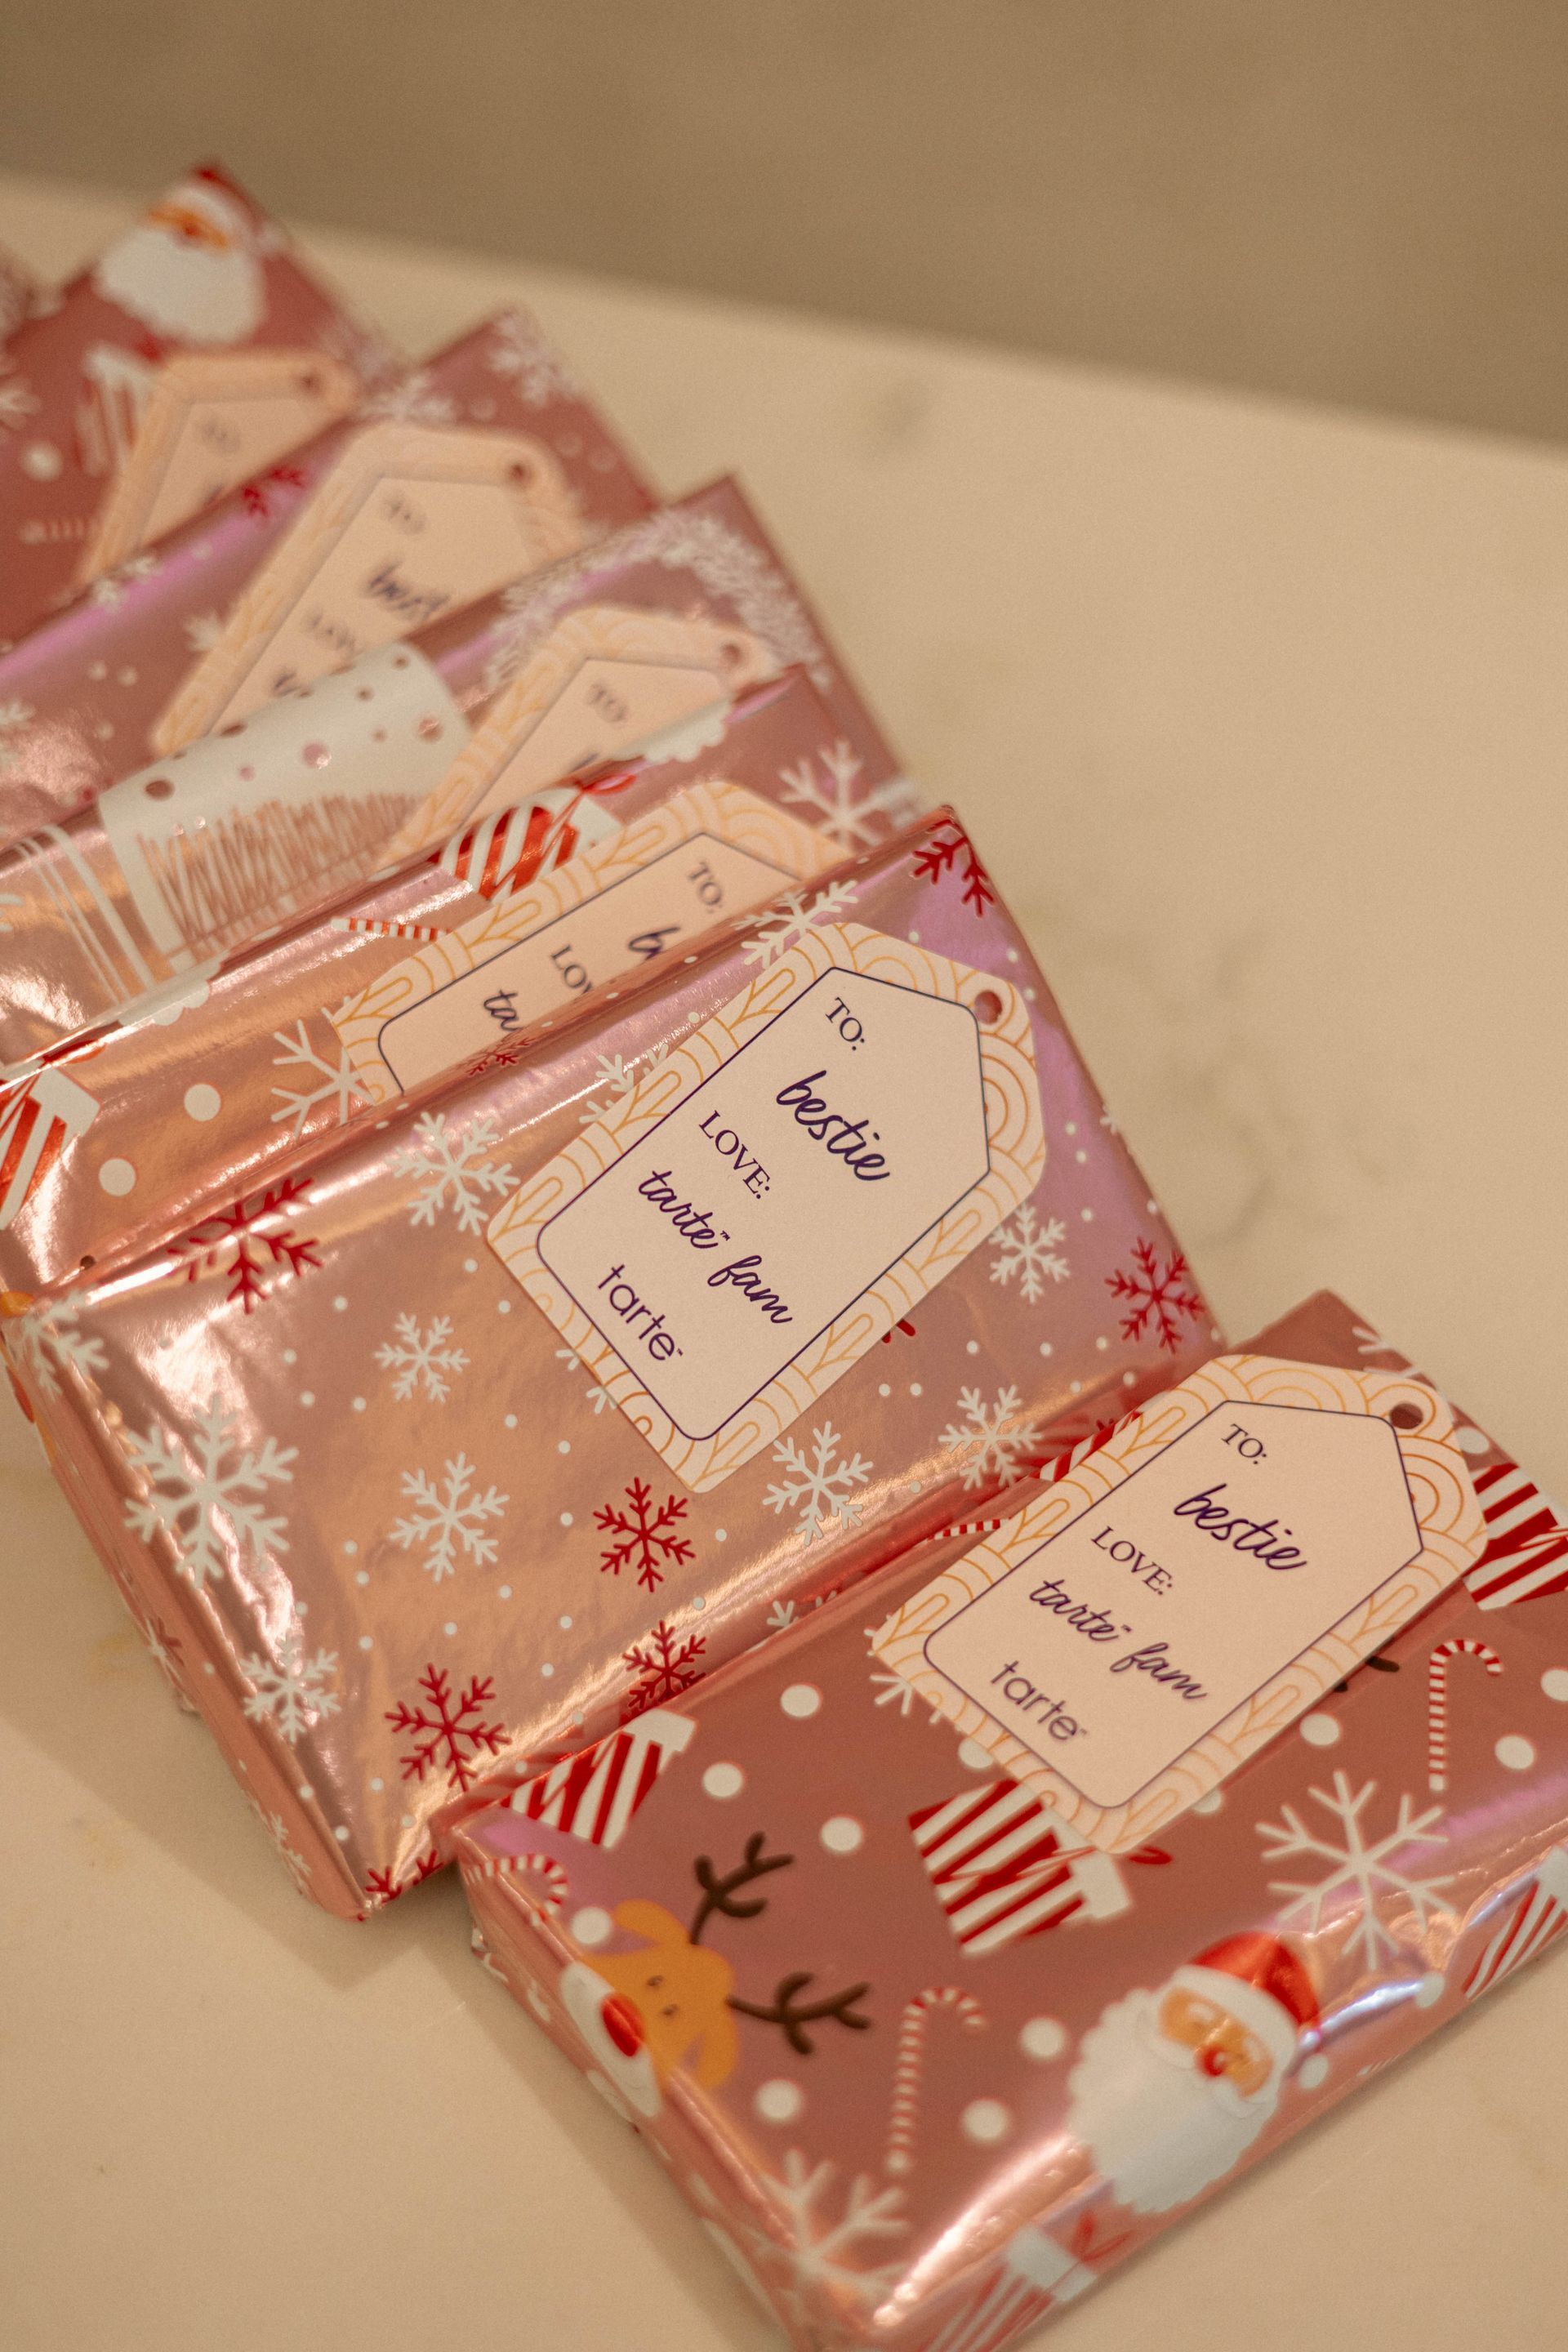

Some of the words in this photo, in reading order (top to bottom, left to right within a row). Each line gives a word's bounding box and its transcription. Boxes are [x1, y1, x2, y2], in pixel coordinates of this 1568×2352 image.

[824, 996, 866, 1052] TO:
[697, 1110, 771, 1200] LOVE:
[776, 1069, 891, 1182] bestie
[706, 1254, 794, 1325] fam
[1220, 1423, 1268, 1466] TO:
[1089, 1525, 1174, 1597] LOVE:
[1172, 1482, 1308, 1571] bestie
[1108, 1641, 1209, 1701] fam
